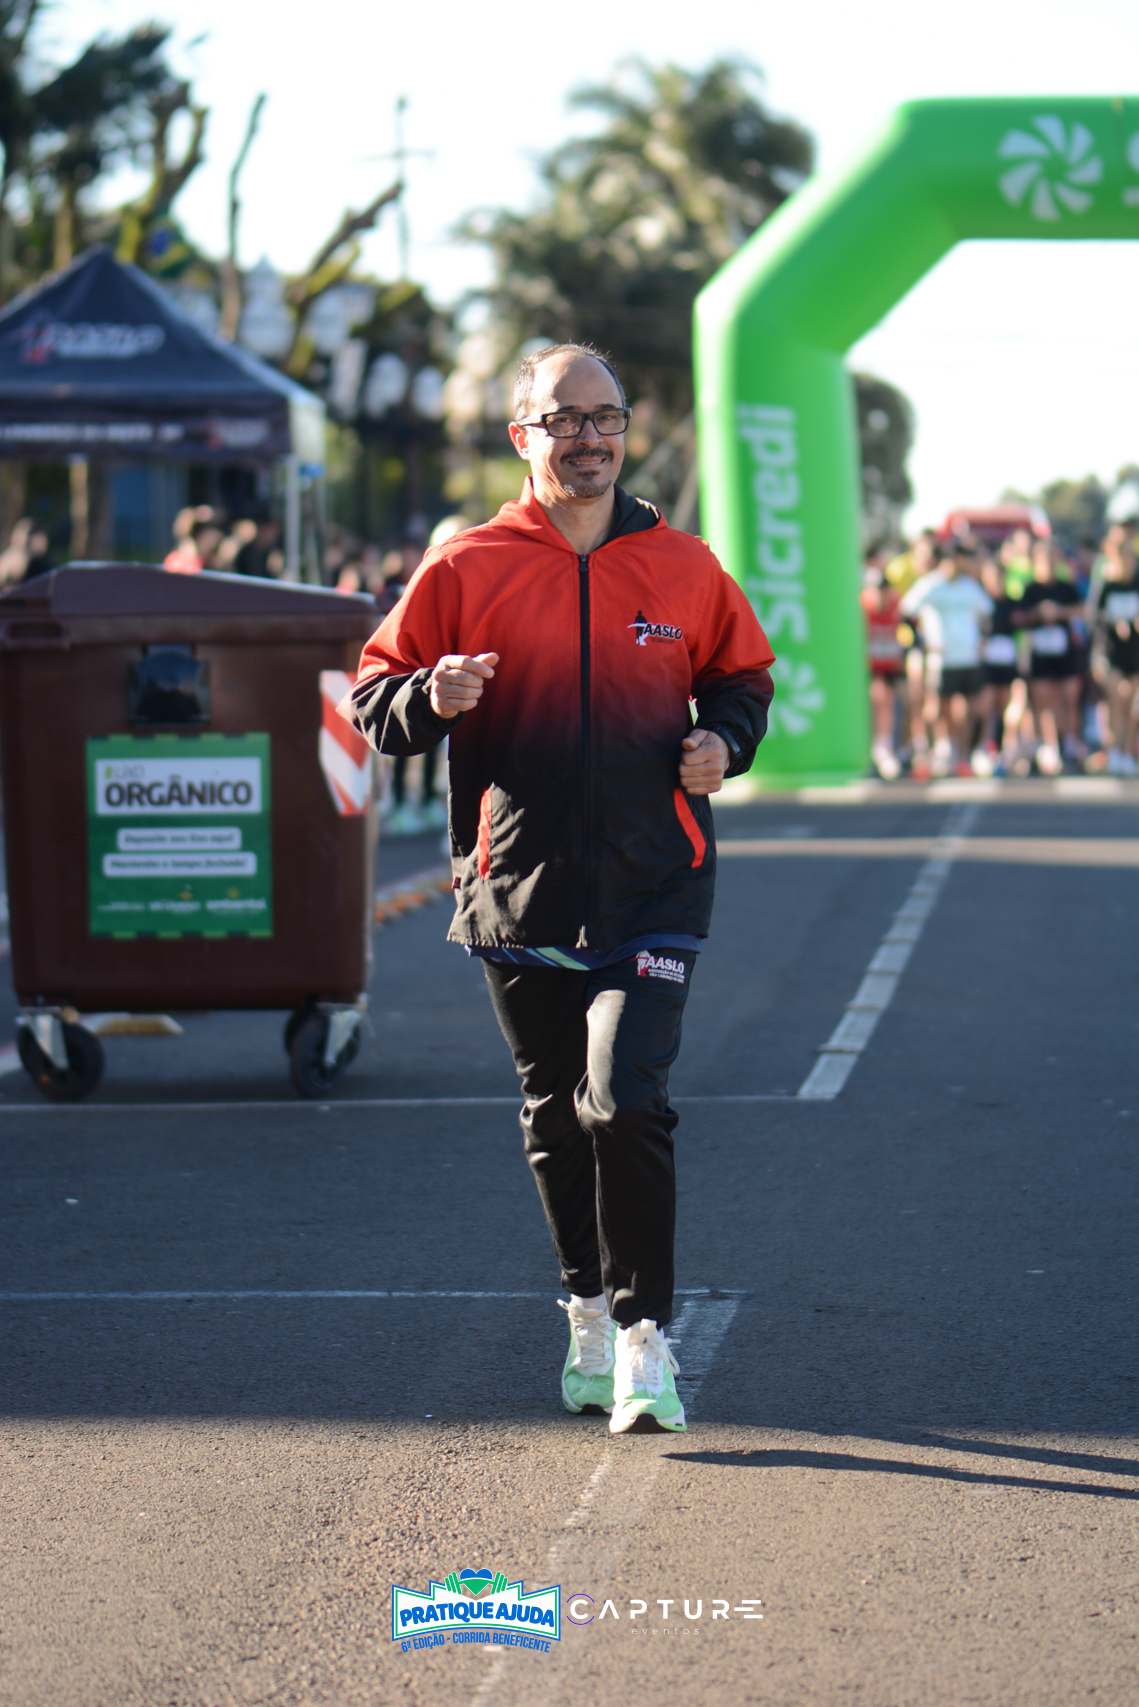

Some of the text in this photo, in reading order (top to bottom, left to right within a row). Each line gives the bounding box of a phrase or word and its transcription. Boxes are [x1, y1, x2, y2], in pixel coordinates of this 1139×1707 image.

[643, 622, 683, 640] AASLO
[105, 774, 253, 807] ORGÂNICO
[645, 955, 685, 974] AASLO
